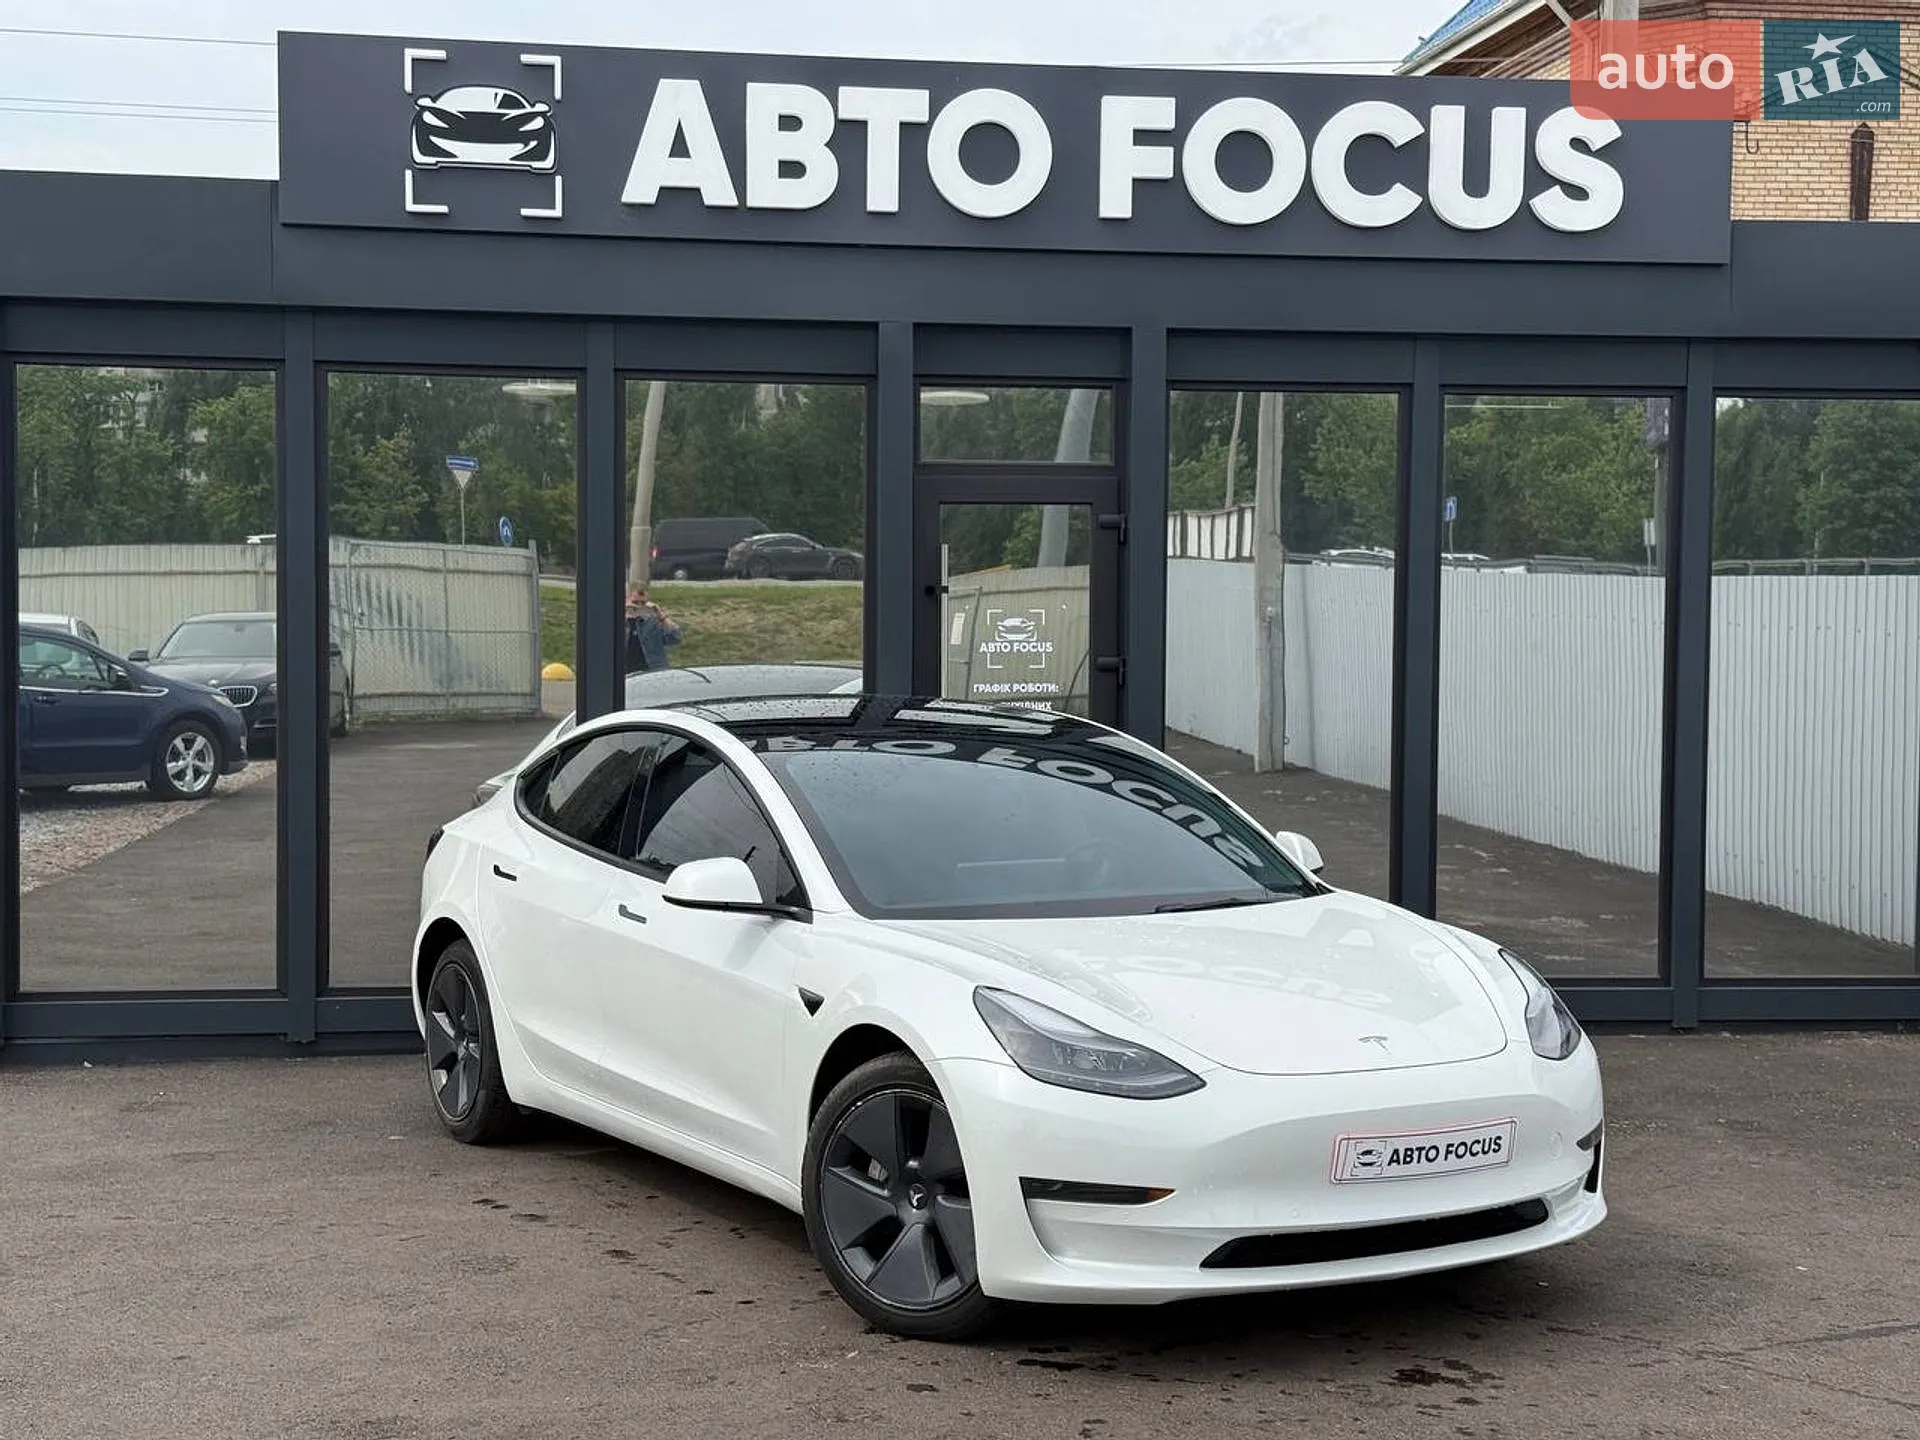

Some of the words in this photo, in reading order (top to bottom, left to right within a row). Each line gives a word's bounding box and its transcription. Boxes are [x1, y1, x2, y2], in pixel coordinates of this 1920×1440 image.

[621, 79, 1053, 218] АВТО
[1100, 96, 1625, 232] FOCUS
[980, 641, 1010, 653] АВТО
[1012, 641, 1054, 653] FOCUS
[1012, 683, 1059, 693] РОБОТИ:
[1387, 1145, 1440, 1167] АВТО
[1444, 1136, 1503, 1163] FOCUS
